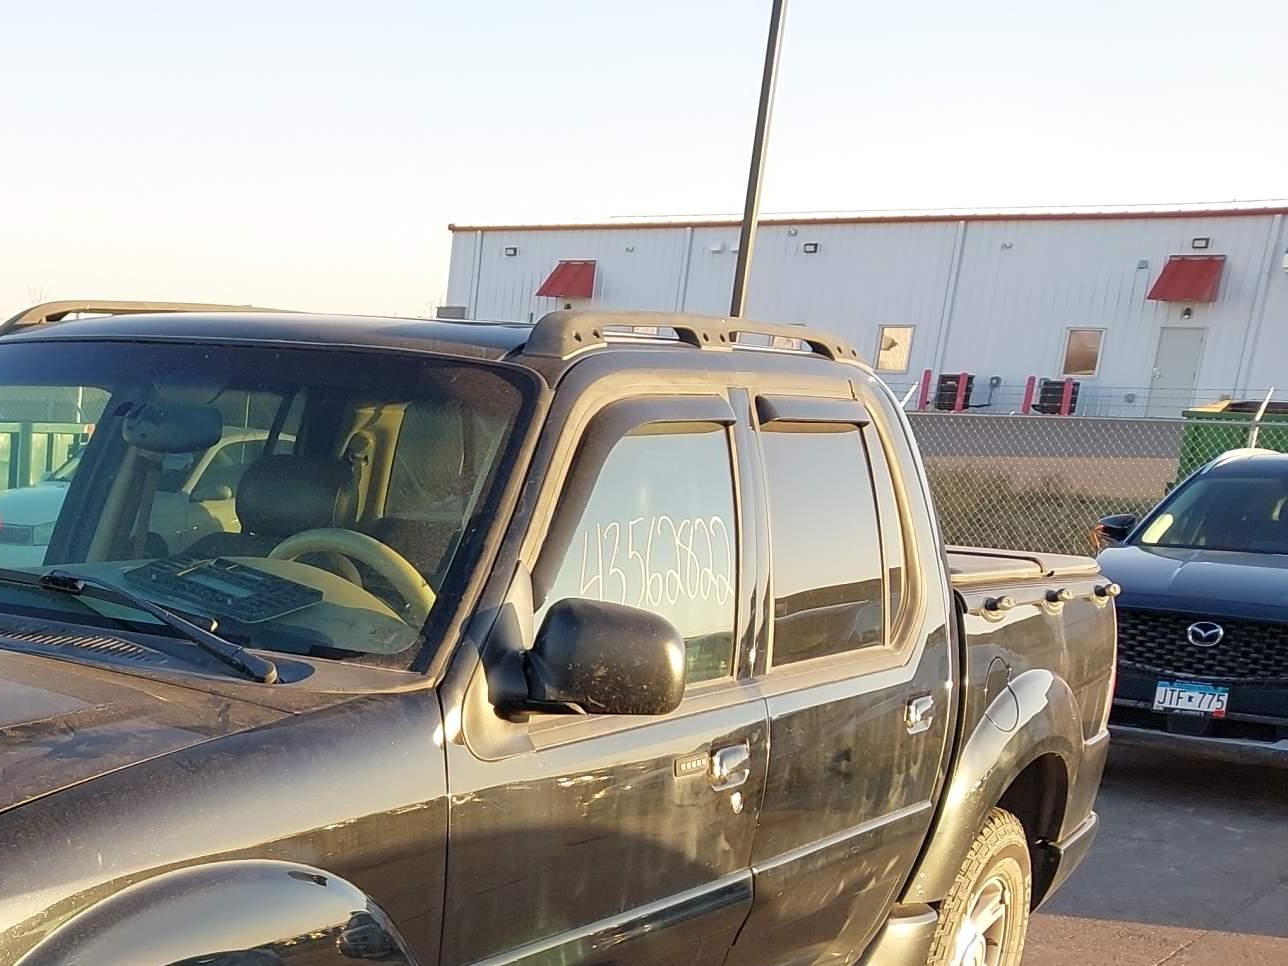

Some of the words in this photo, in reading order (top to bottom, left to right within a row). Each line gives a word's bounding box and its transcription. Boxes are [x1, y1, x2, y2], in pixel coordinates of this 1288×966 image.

[579, 515, 735, 607] 43562822
[1157, 687, 1187, 707] JTF
[1197, 691, 1226, 710] 775
